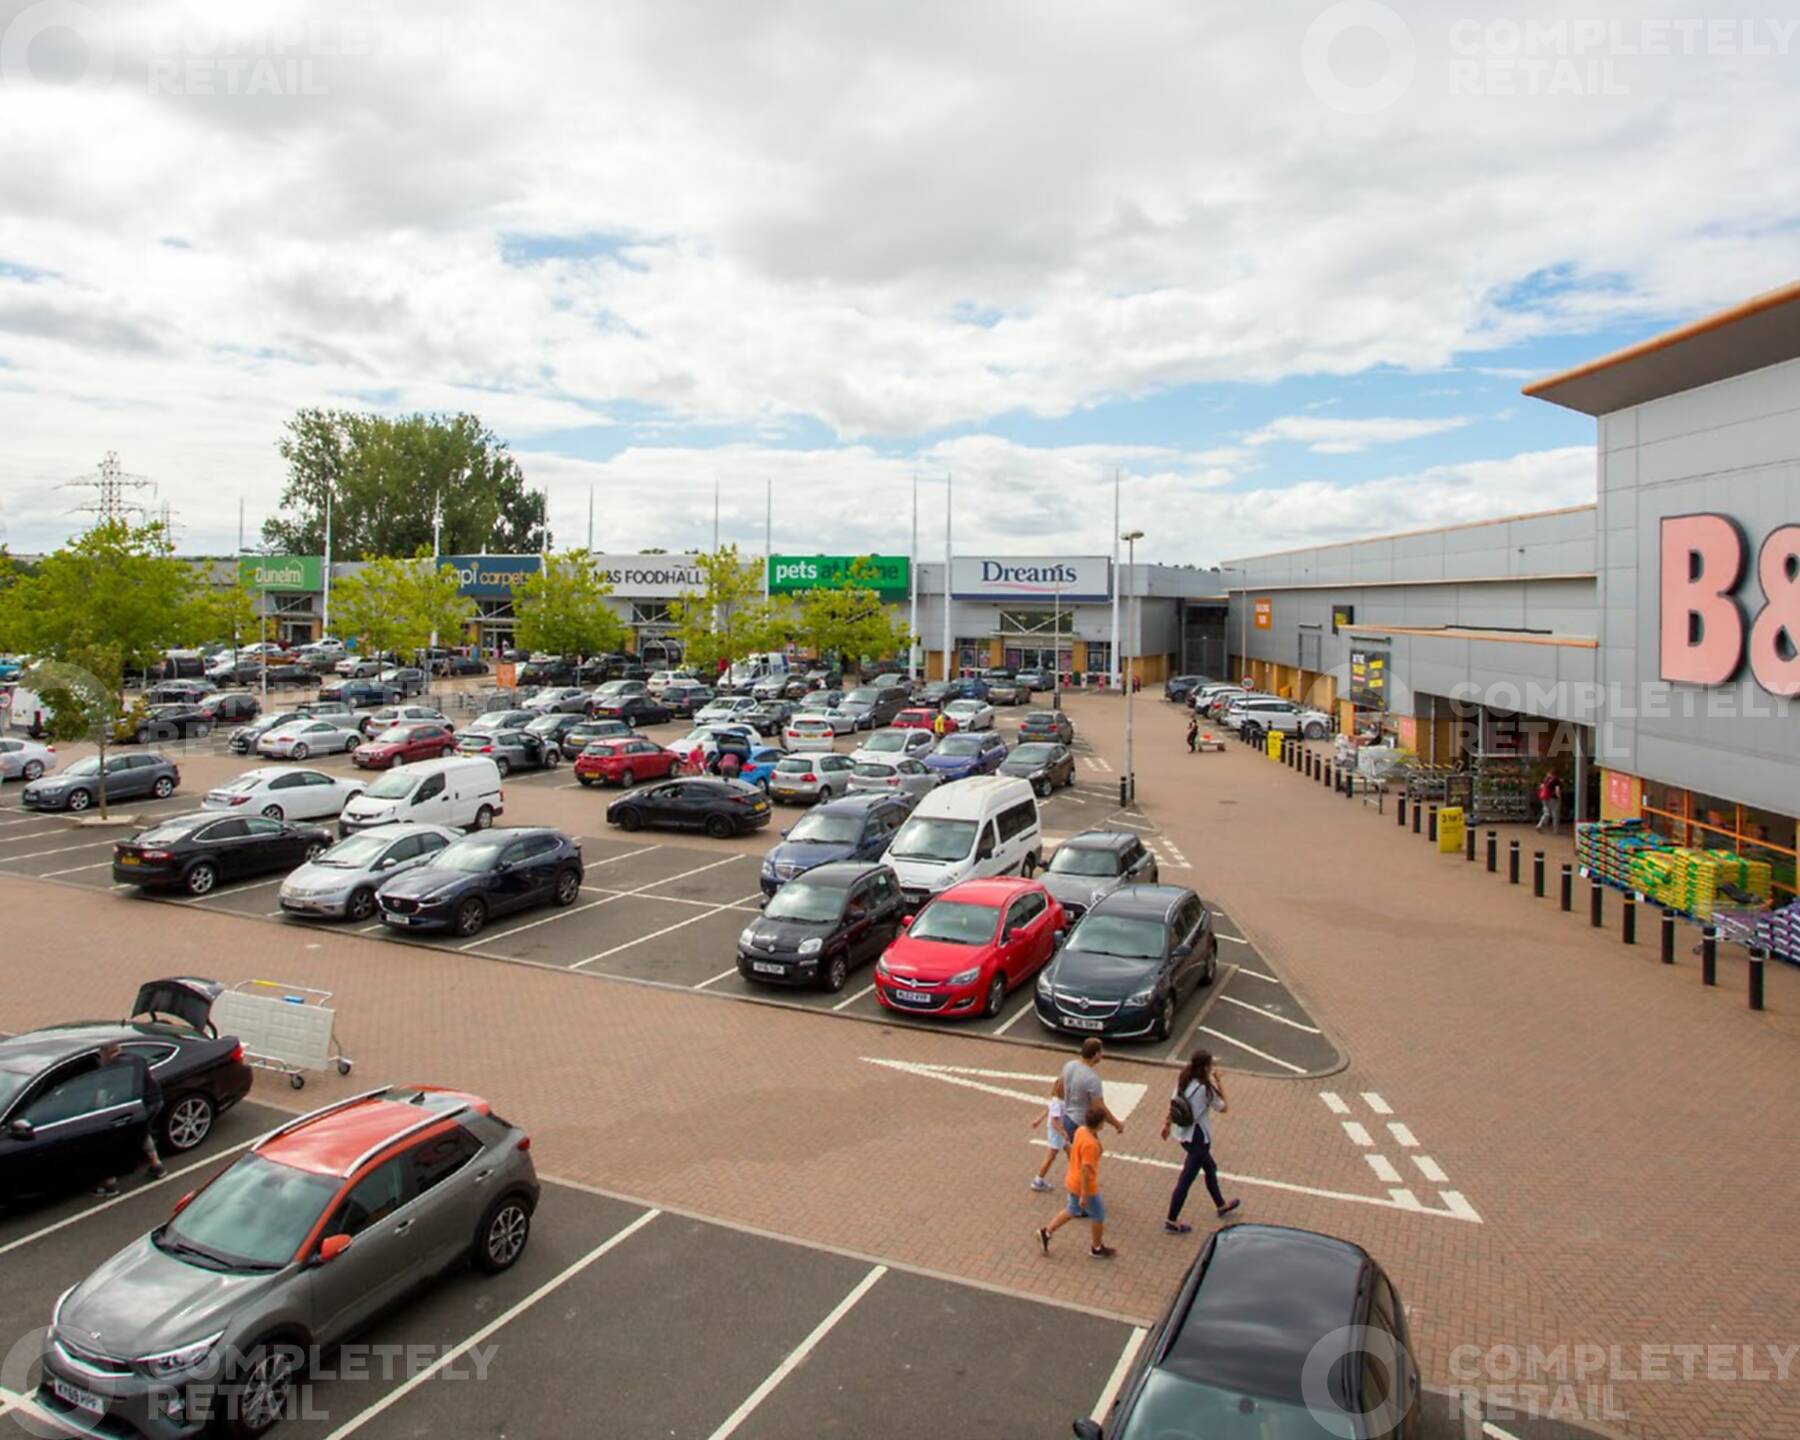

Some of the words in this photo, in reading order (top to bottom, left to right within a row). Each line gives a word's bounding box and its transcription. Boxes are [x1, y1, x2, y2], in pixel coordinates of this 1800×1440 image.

[255, 567, 301, 583] Dunelm
[625, 569, 704, 584] FOODHALL
[776, 561, 817, 583] pets
[982, 560, 1077, 583] Dreams
